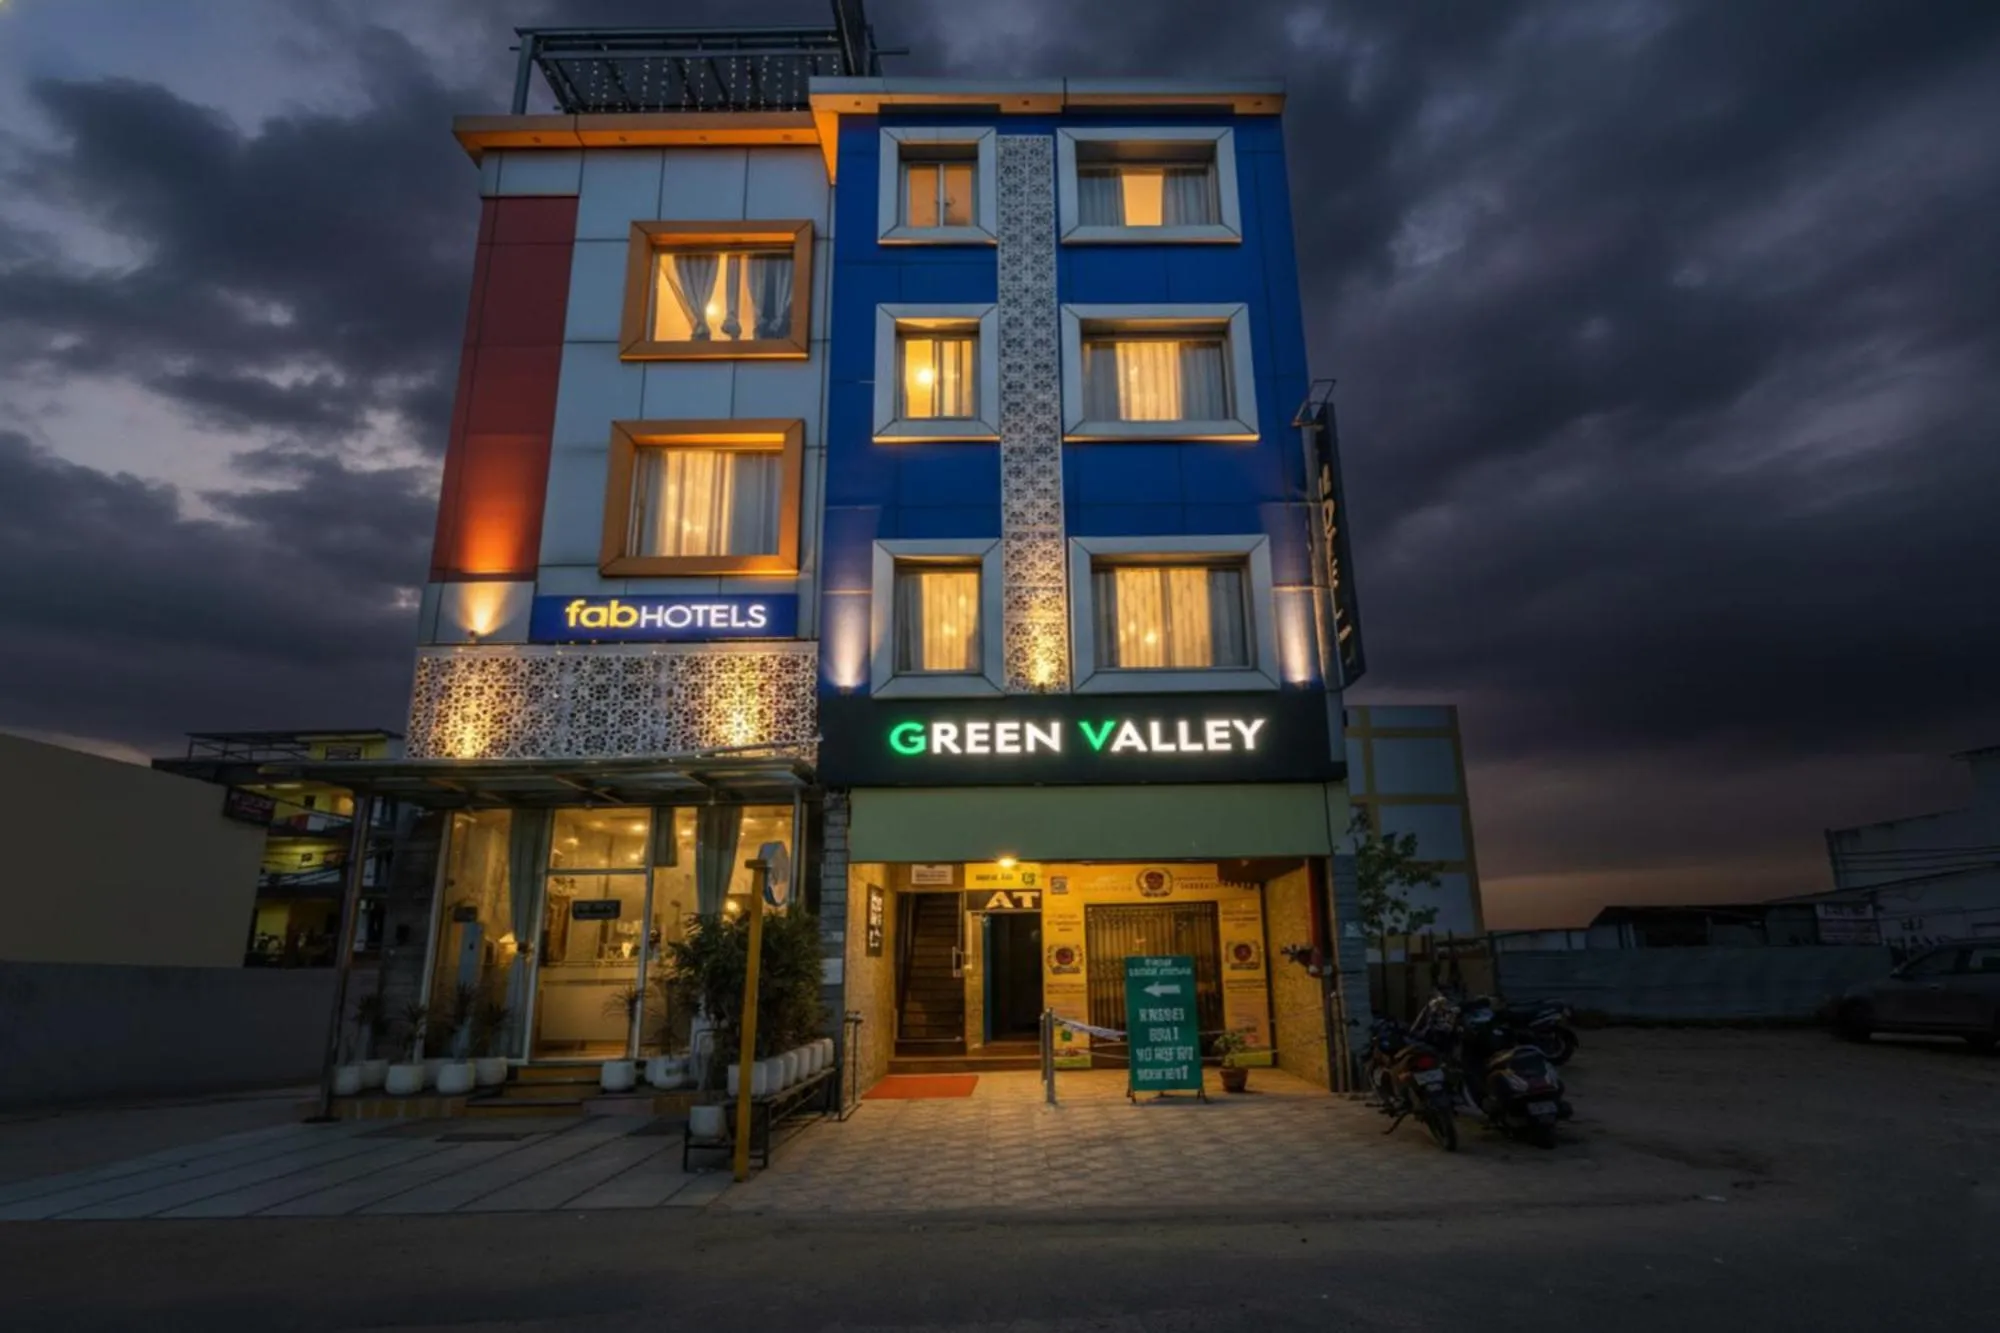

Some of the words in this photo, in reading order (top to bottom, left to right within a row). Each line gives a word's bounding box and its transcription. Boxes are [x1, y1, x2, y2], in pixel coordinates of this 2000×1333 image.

[565, 600, 767, 628] fabHOTELS
[889, 721, 1061, 755] GREEN
[1078, 718, 1267, 753] VALLEY
